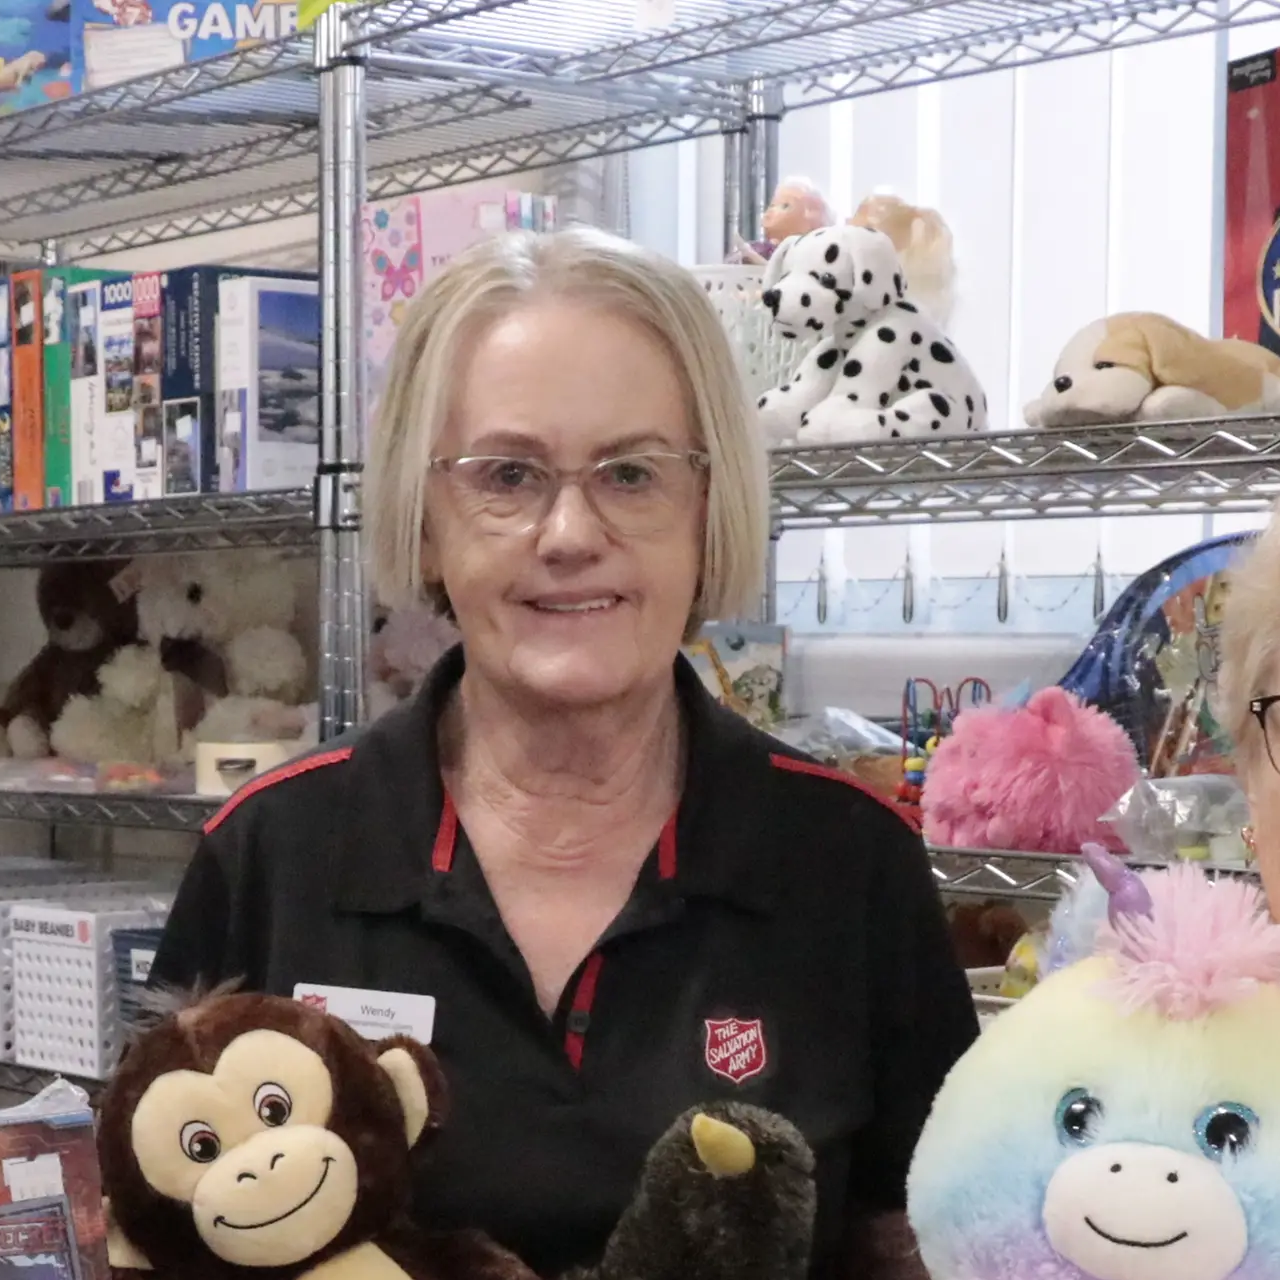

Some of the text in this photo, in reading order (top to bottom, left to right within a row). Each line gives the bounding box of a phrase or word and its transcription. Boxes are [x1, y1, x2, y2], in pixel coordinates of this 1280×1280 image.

[104, 281, 132, 304] 1000
[13, 918, 74, 938] BABY BEANIES
[360, 1005, 396, 1020] Wendy
[714, 1022, 739, 1041] THE
[709, 1026, 758, 1065] SALVATION
[728, 1043, 758, 1075] ARMY
